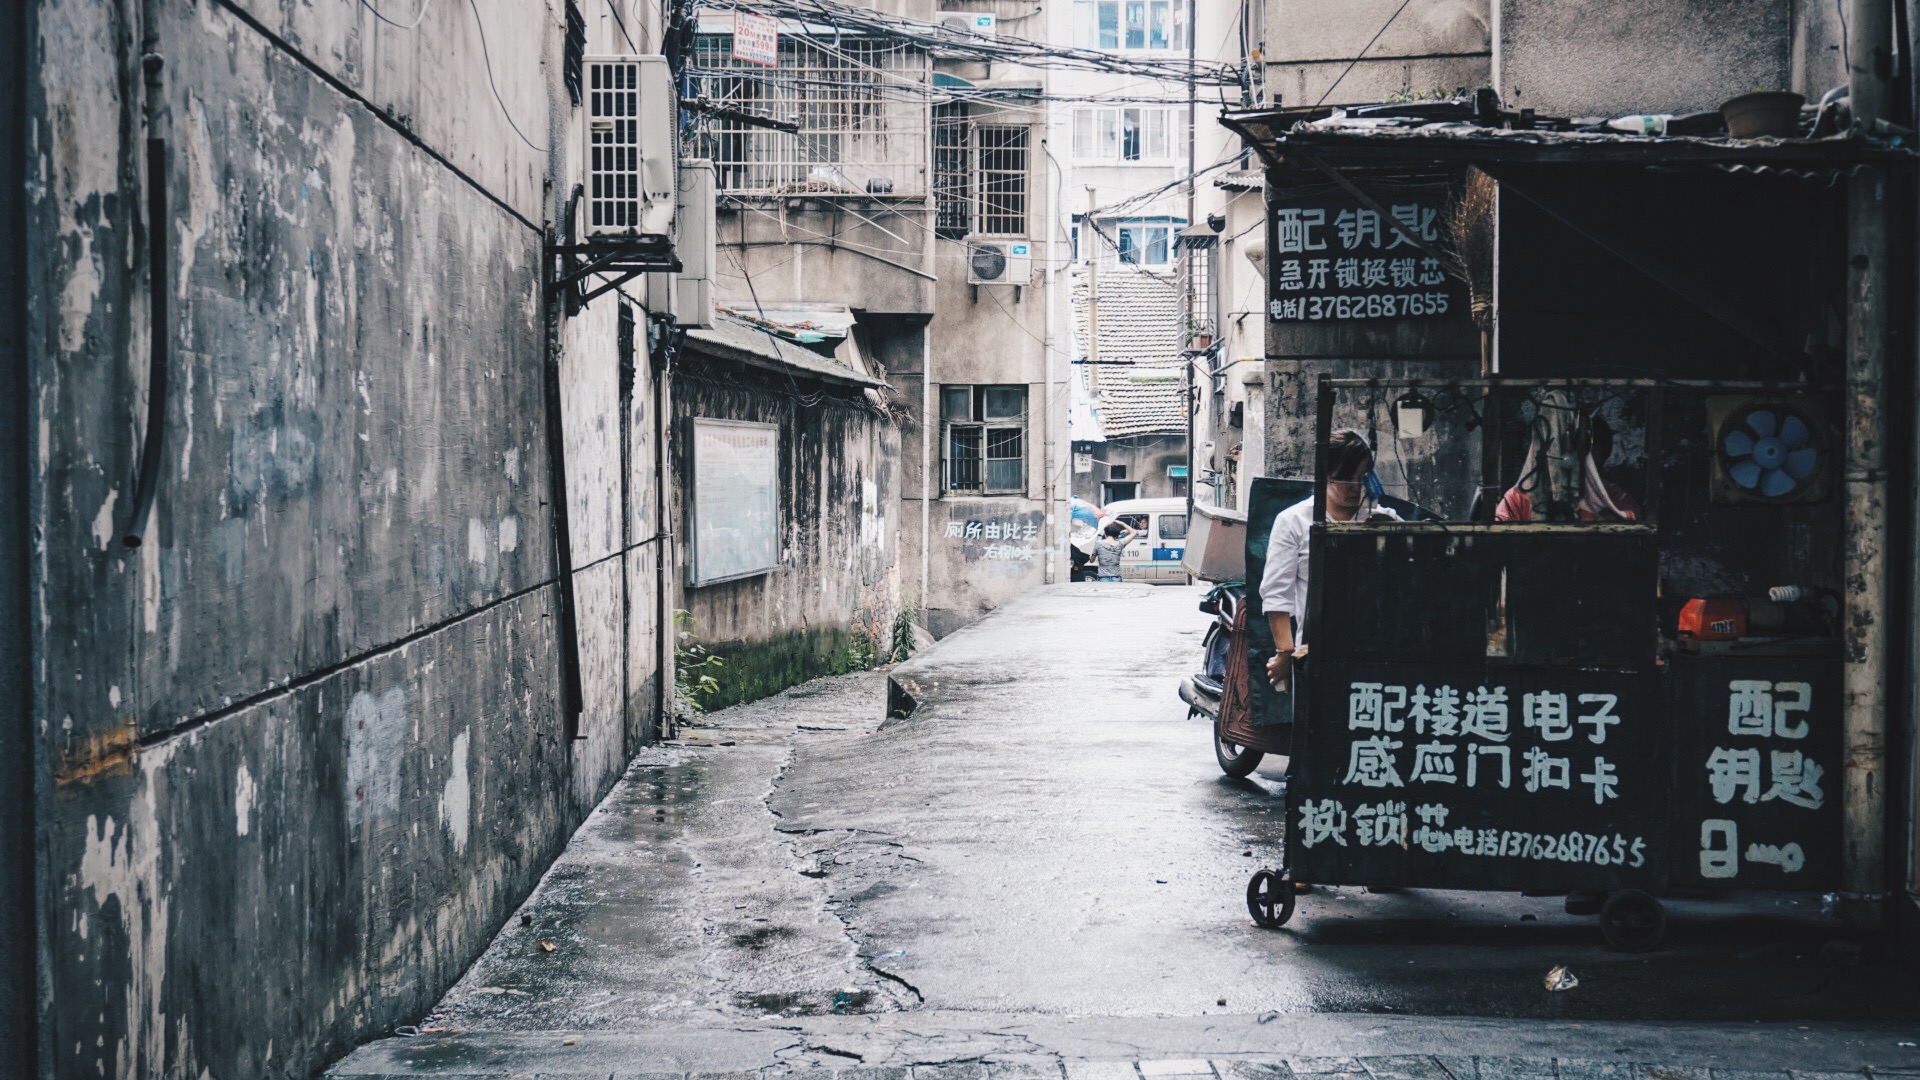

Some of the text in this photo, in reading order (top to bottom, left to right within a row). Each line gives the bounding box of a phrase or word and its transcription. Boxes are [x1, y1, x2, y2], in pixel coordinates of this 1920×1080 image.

[1277, 203, 1438, 253] 配钥匙
[1279, 257, 1445, 291] 急开锁换锁芯
[1270, 291, 1449, 321] 电话13762687655
[943, 520, 1038, 541] 厕所由此去
[1127, 550, 1139, 558] 110
[1348, 682, 1621, 744] 配楼道电子
[1728, 679, 1811, 739] 配
[1342, 735, 1619, 804] 感应门扣卡
[1705, 746, 1825, 810] 钥匙
